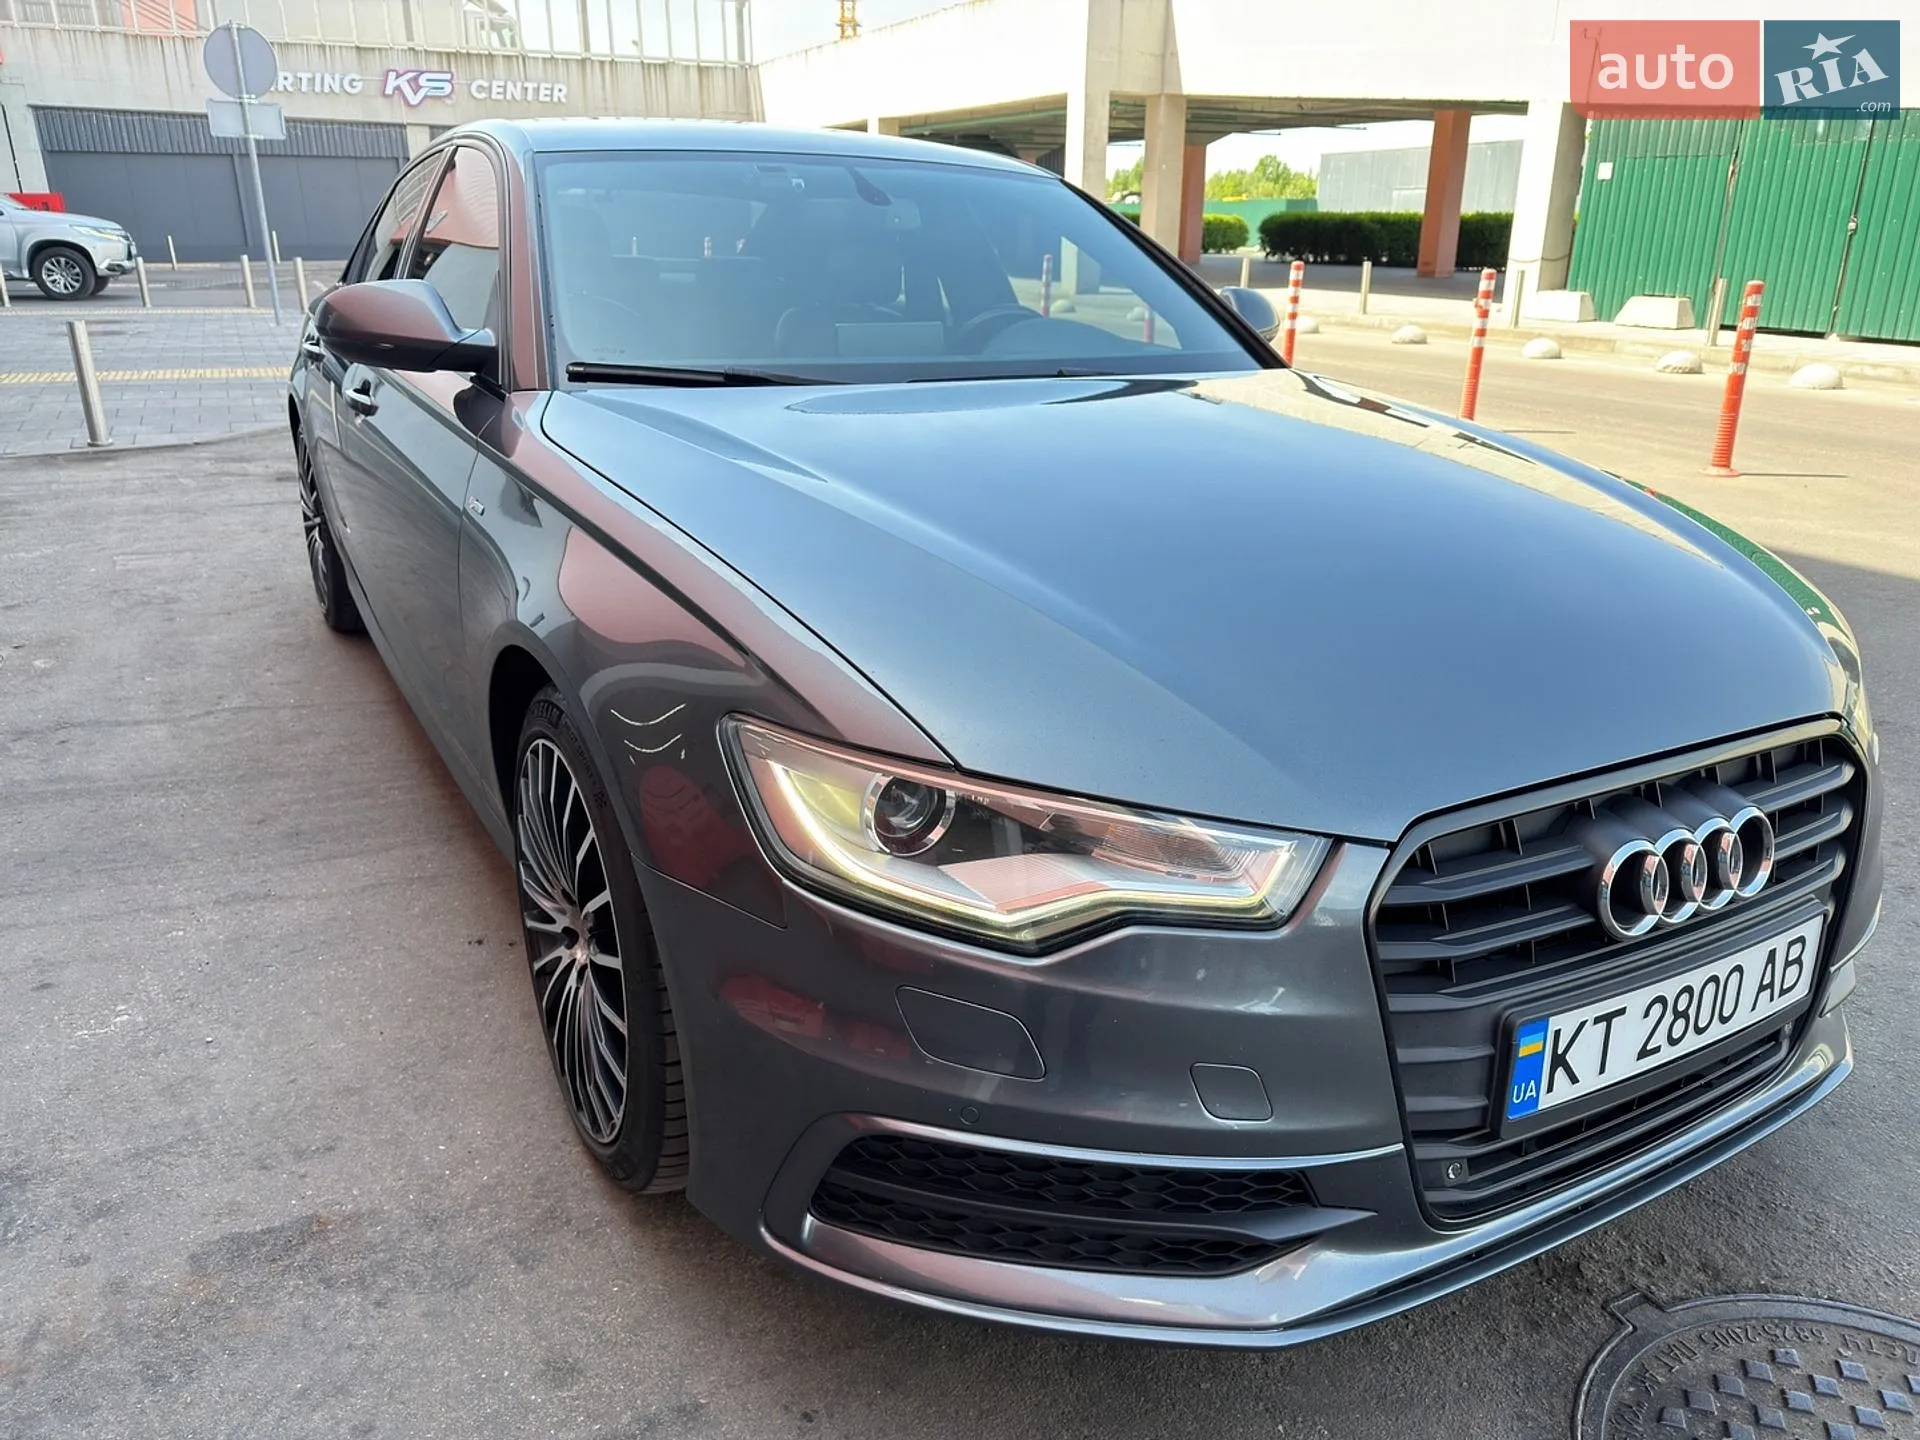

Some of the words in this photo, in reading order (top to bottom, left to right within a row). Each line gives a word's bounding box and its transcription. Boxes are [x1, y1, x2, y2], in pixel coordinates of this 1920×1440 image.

[270, 72, 364, 95] RTING
[470, 79, 568, 103] CENTER
[1546, 1006, 1628, 1095] KT
[1636, 964, 1745, 1062] 2800
[1751, 934, 1807, 1012] AB
[1512, 1079, 1537, 1104] UA
